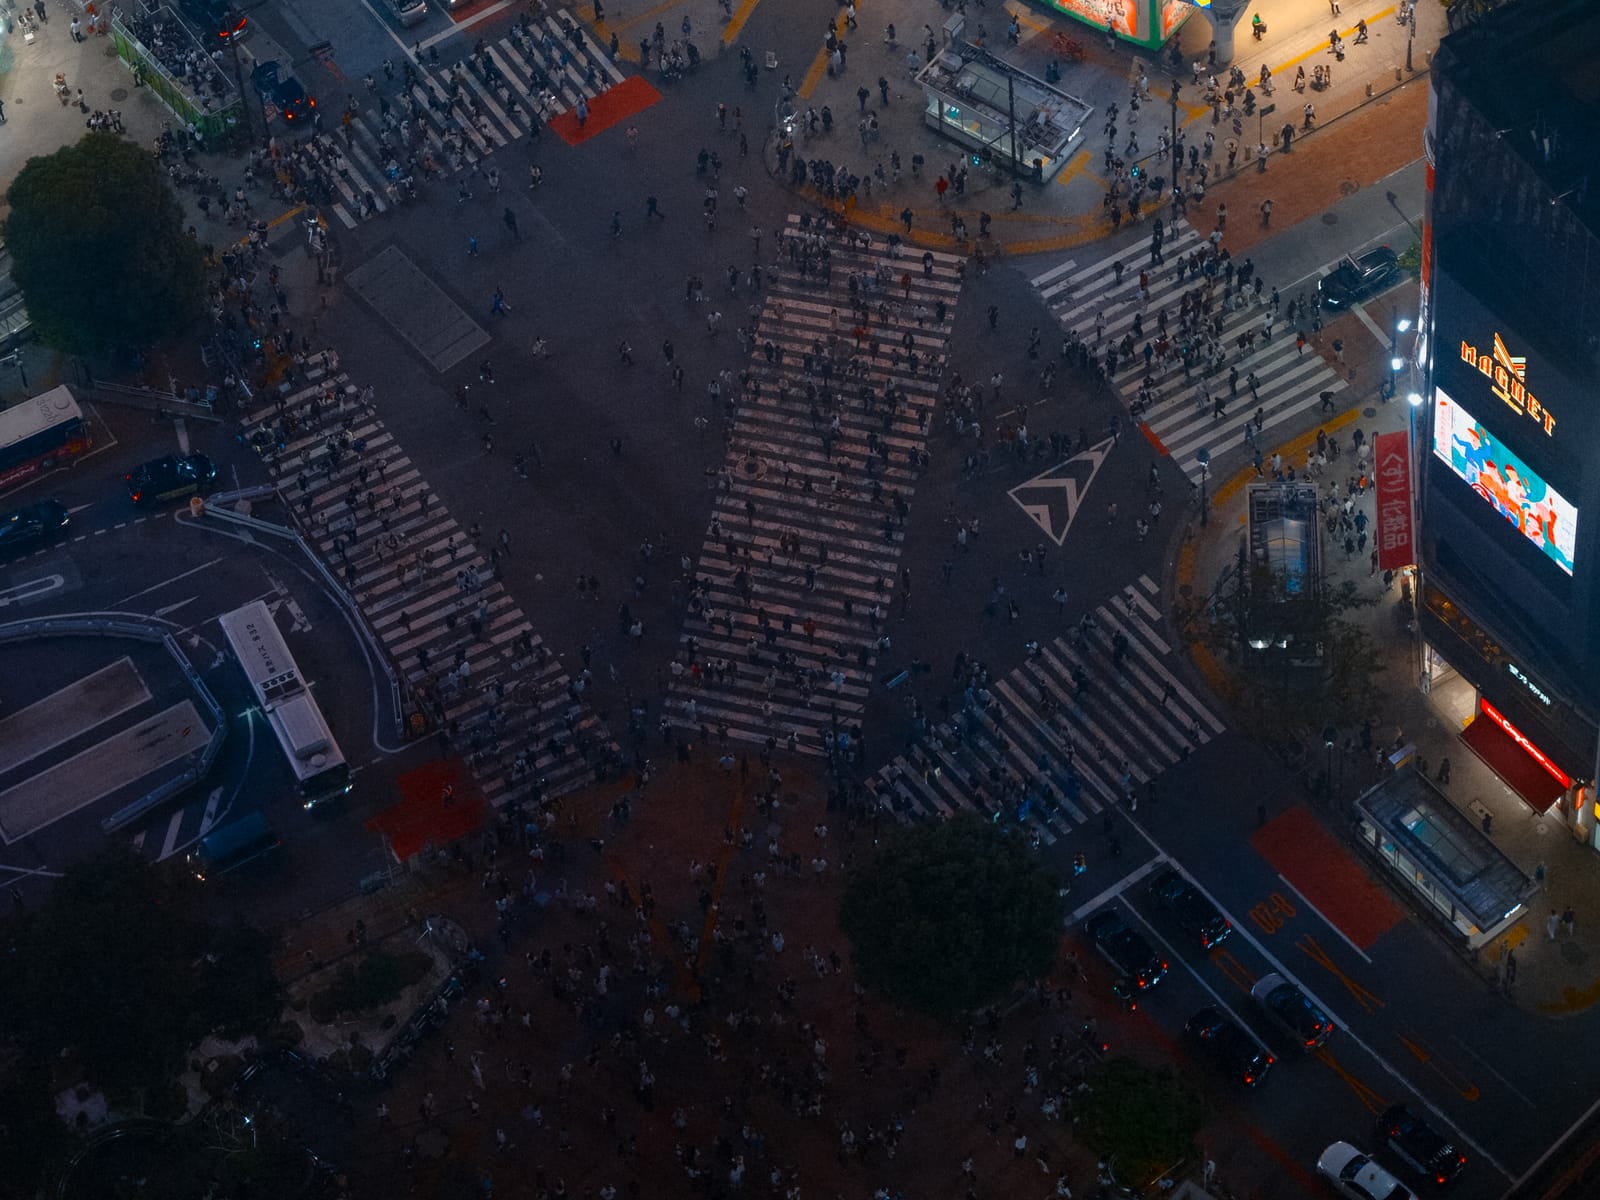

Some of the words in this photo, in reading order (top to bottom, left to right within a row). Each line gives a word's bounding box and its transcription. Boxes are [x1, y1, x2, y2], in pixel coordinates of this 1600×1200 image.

[1461, 340, 1556, 437] MAGNET
[1381, 452, 1406, 493] くすり
[1382, 500, 1408, 551] 化粧品
